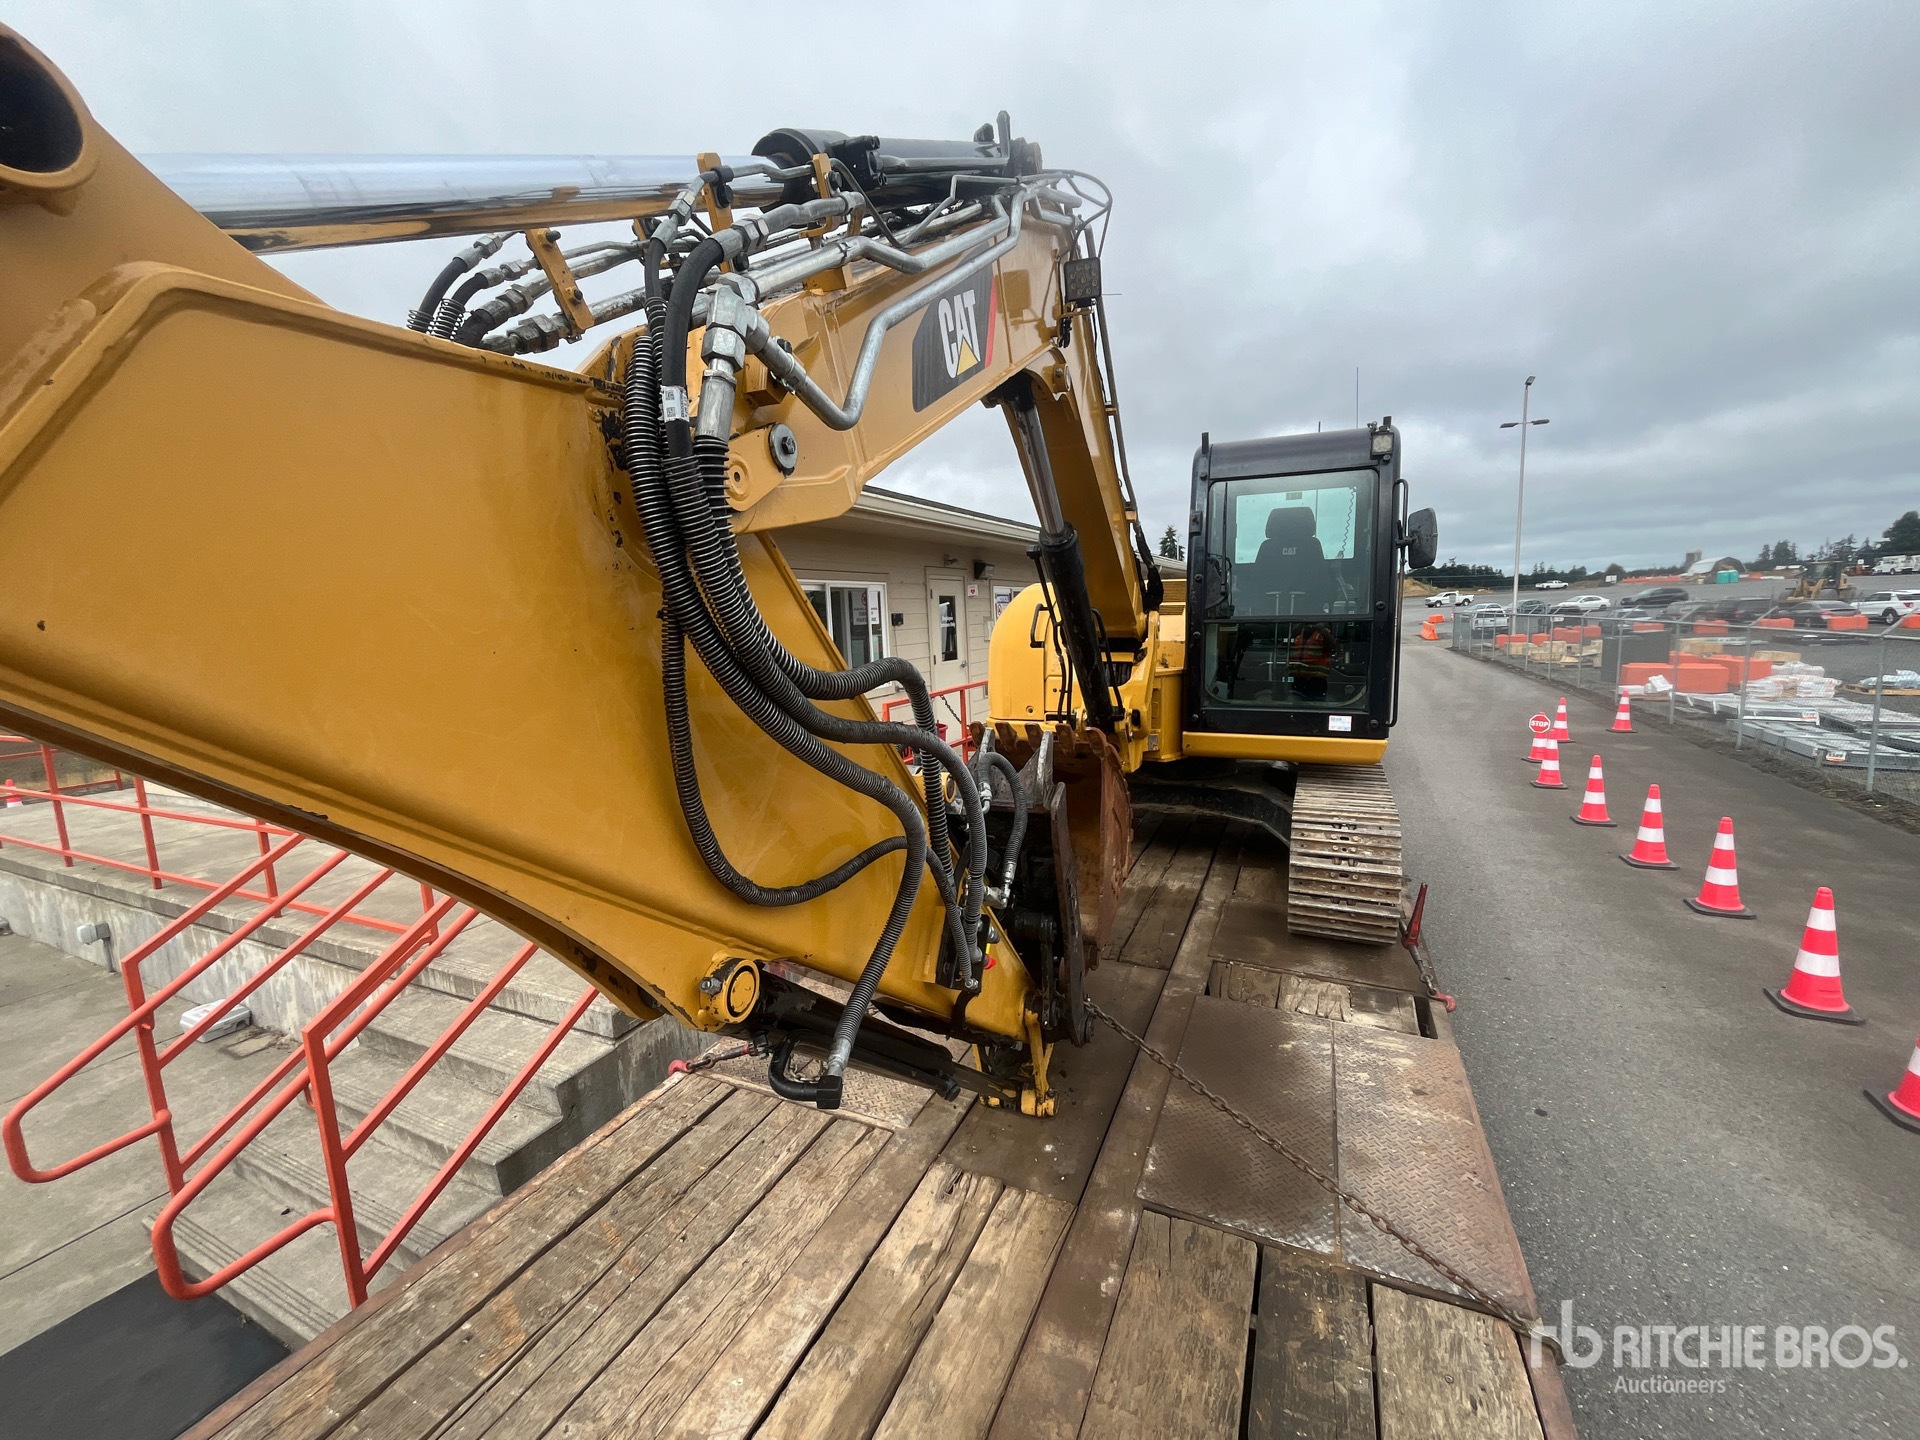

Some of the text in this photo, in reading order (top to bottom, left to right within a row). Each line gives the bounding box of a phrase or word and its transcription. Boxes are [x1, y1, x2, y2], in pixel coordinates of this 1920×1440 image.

[938, 289, 981, 379] CAT
[1282, 546, 1297, 556] CAT
[1530, 720, 1549, 728] STOP
